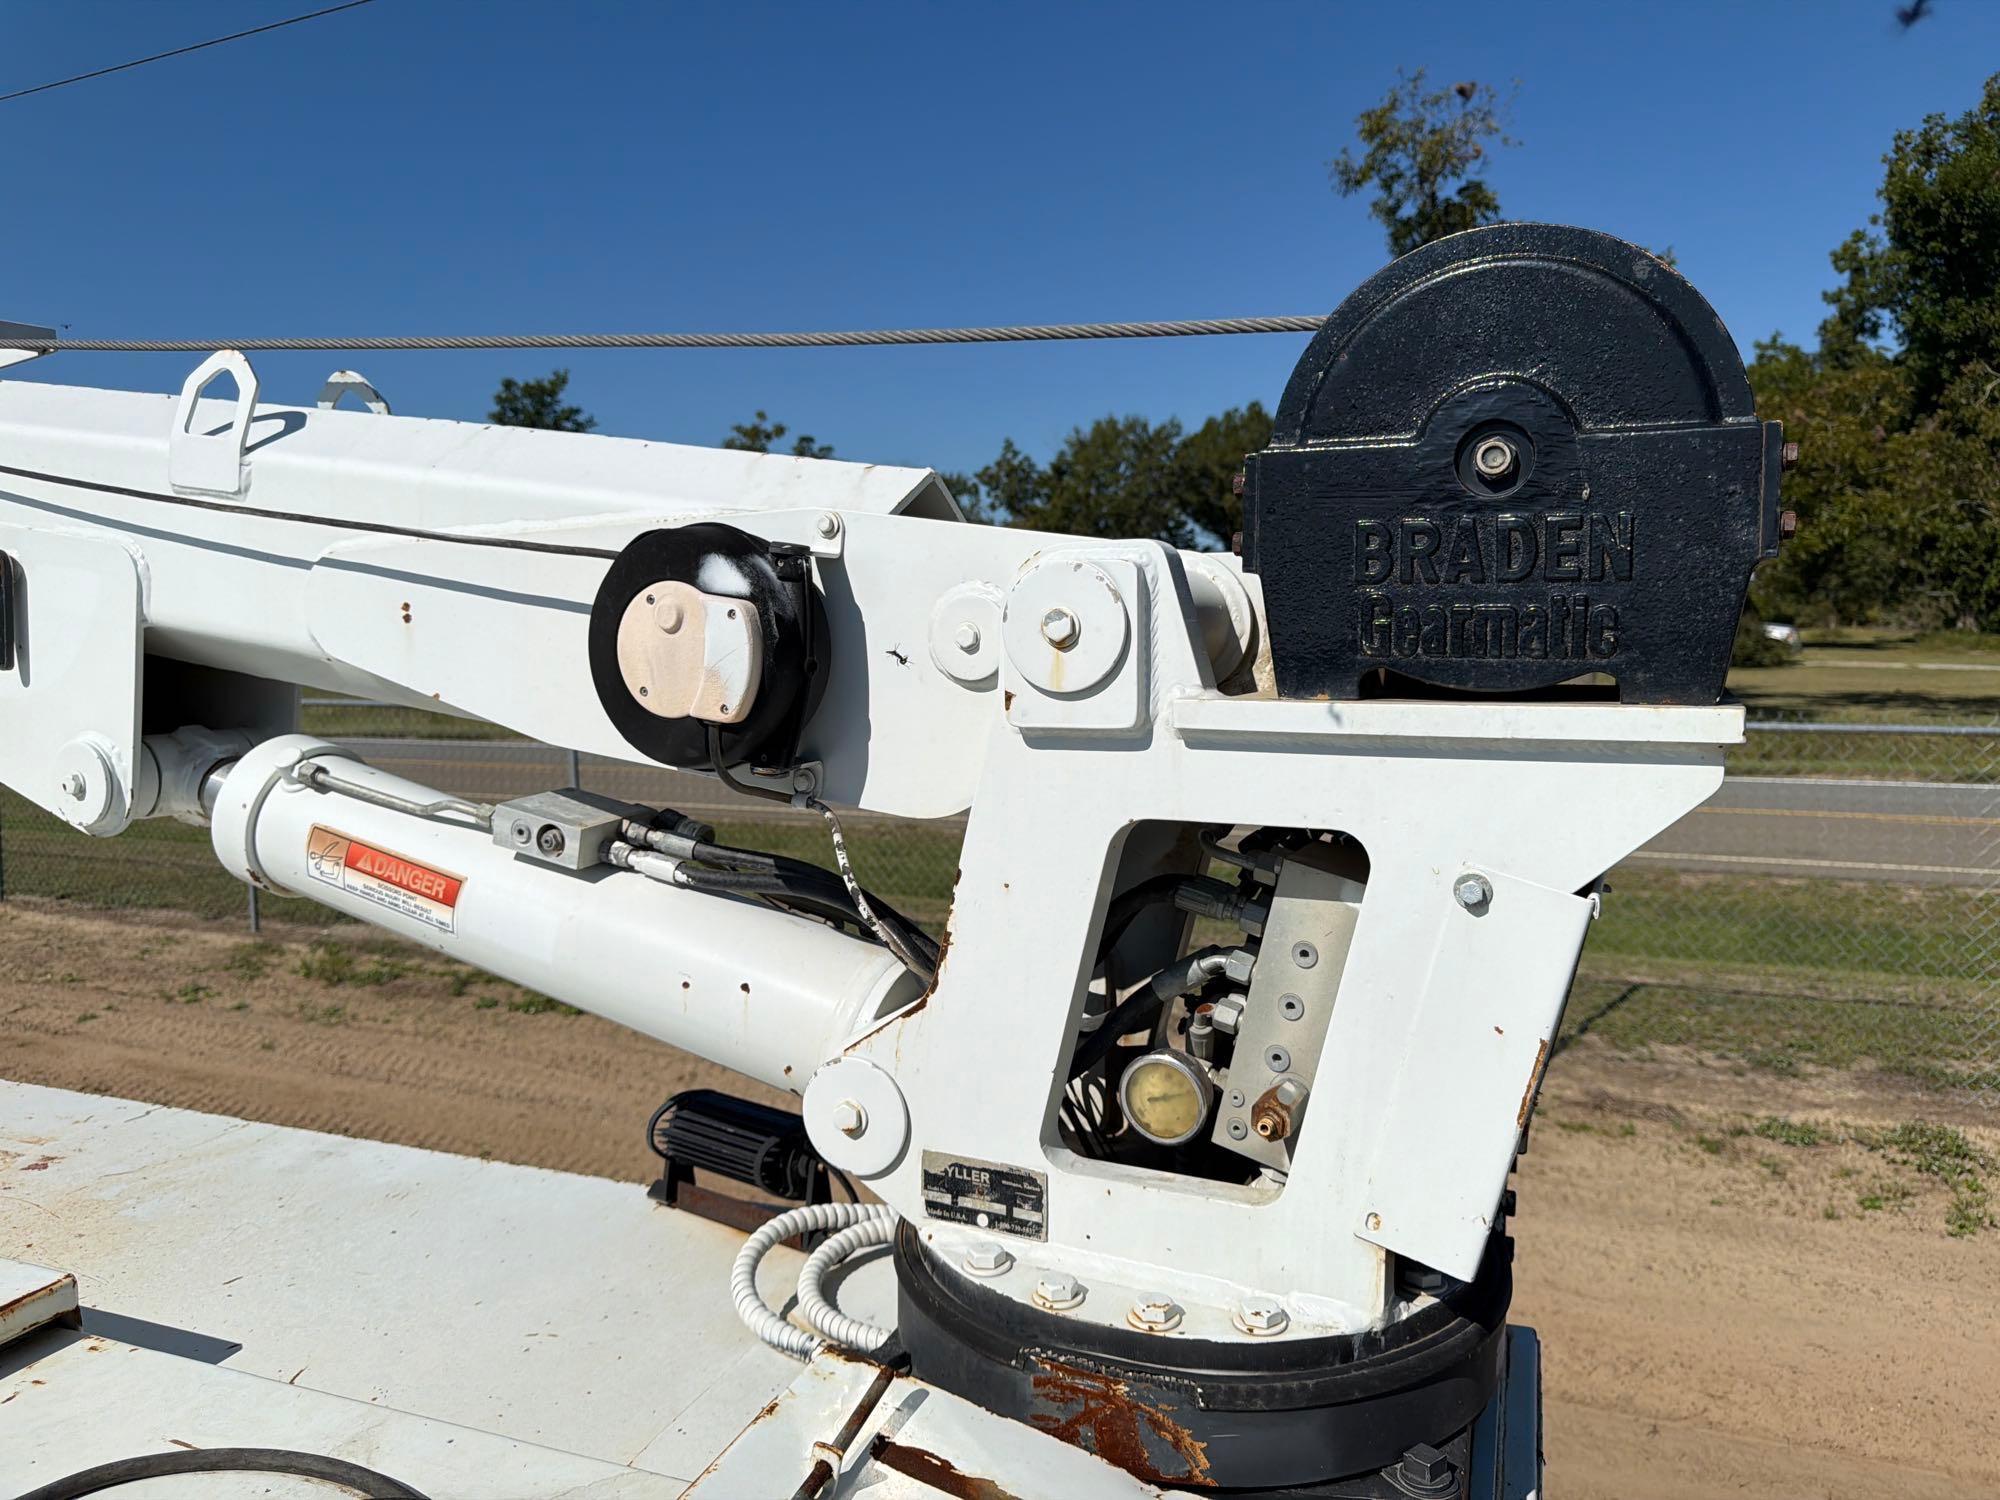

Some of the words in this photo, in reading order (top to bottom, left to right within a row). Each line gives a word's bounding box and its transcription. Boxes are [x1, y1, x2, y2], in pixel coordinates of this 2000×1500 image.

[1354, 511, 1634, 584] BRADEN
[1358, 592, 1620, 659] Gearmatic
[374, 857, 446, 899] DANGER
[402, 892, 417, 901] POINT
[413, 903, 432, 914] RESULT
